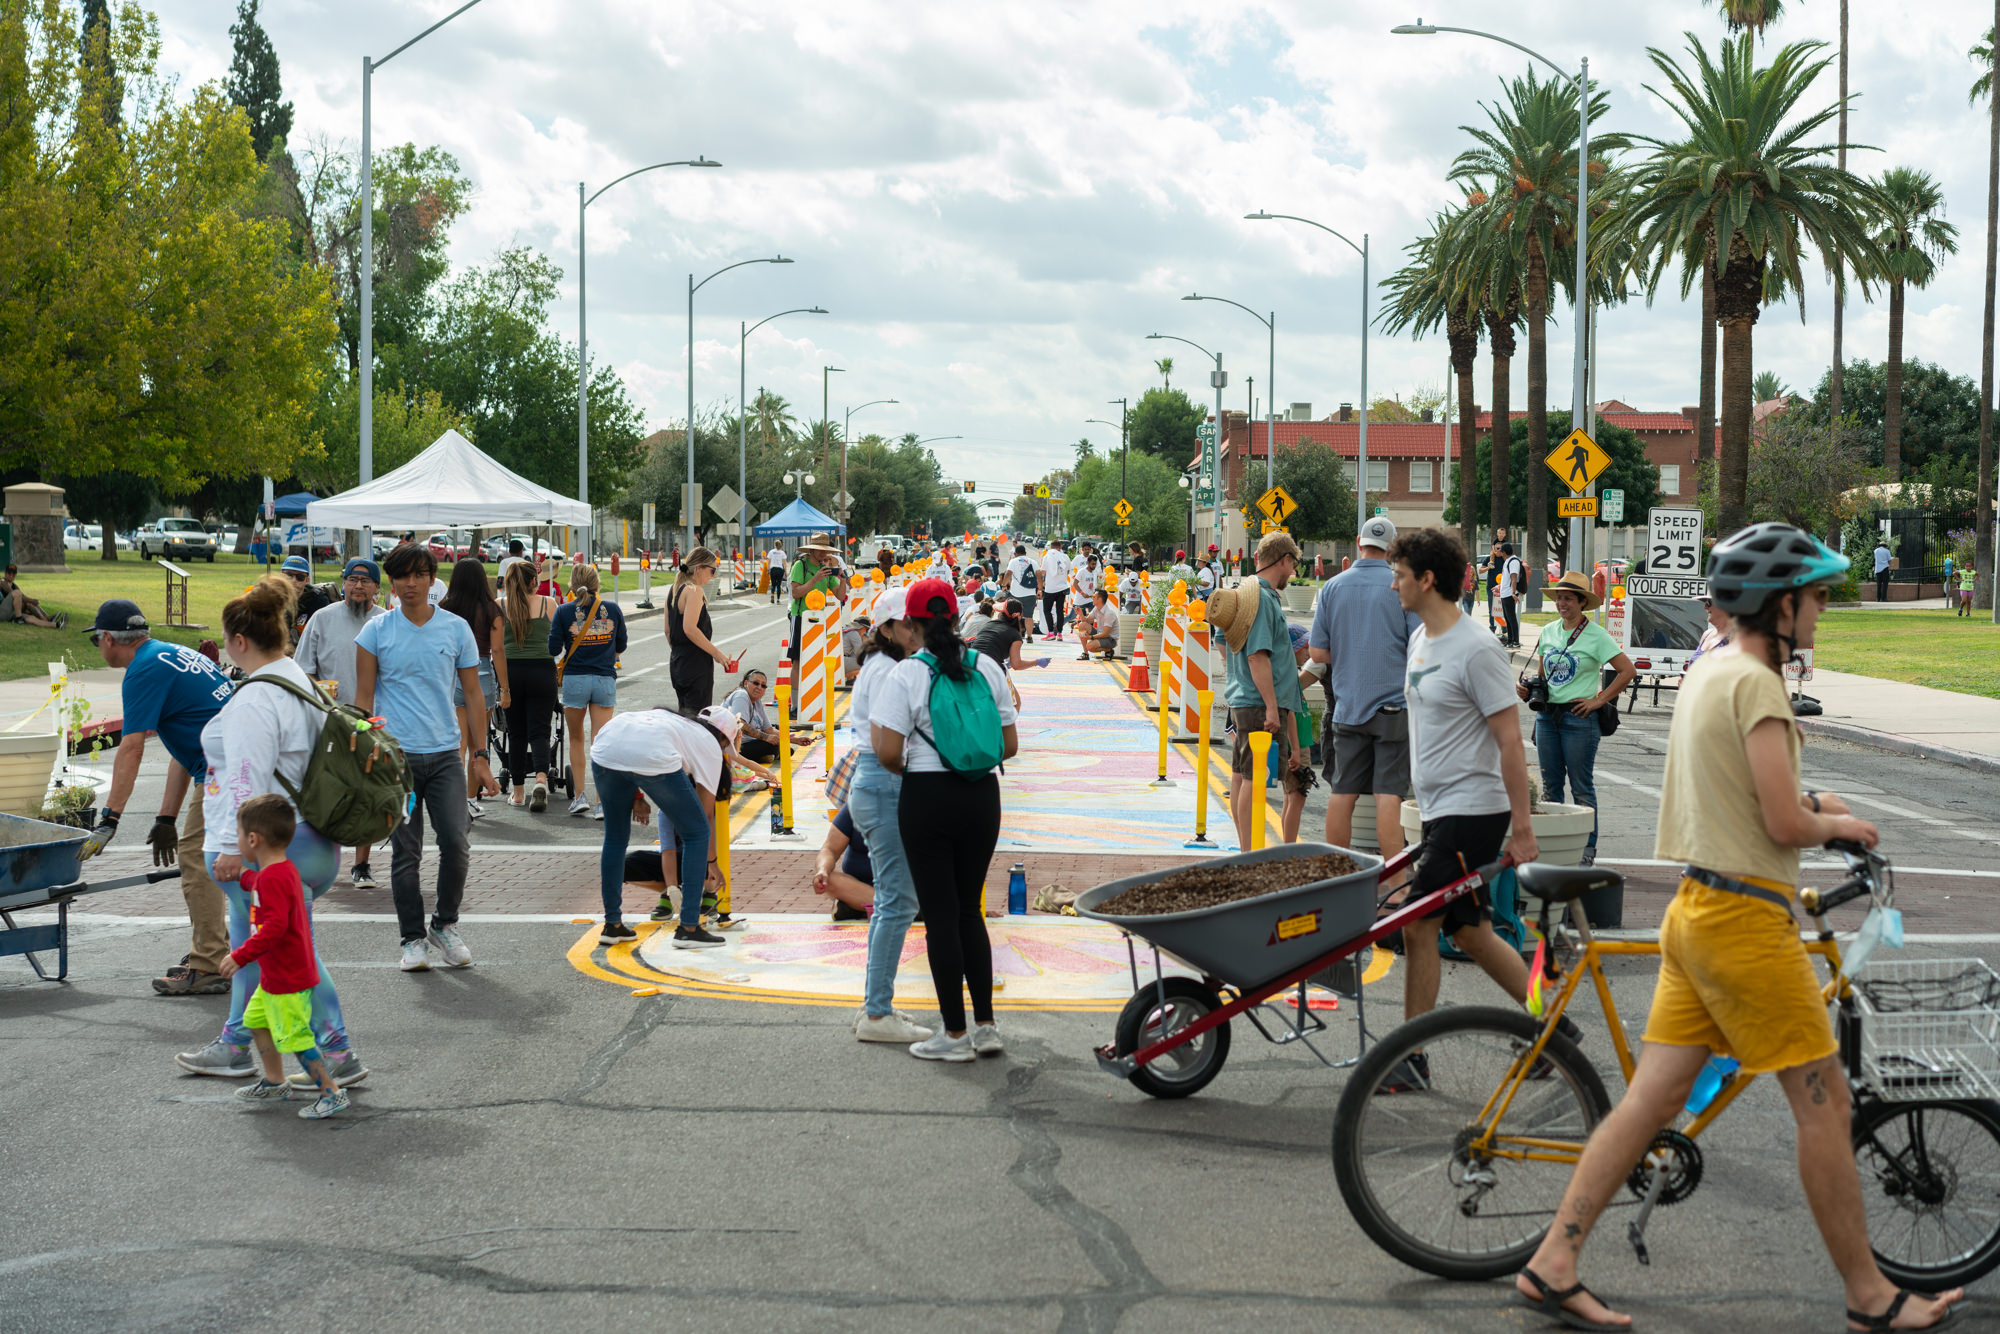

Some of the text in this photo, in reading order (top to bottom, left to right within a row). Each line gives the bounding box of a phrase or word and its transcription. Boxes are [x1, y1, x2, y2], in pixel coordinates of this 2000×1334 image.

[1564, 502, 1593, 512] AHEAD
[1654, 516, 1698, 528] SPEED
[1657, 530, 1693, 541] LIMIT
[1651, 545, 1696, 569] 25
[1631, 579, 1708, 596] YOUR SPEE
[1788, 665, 1812, 674] PARKNG
